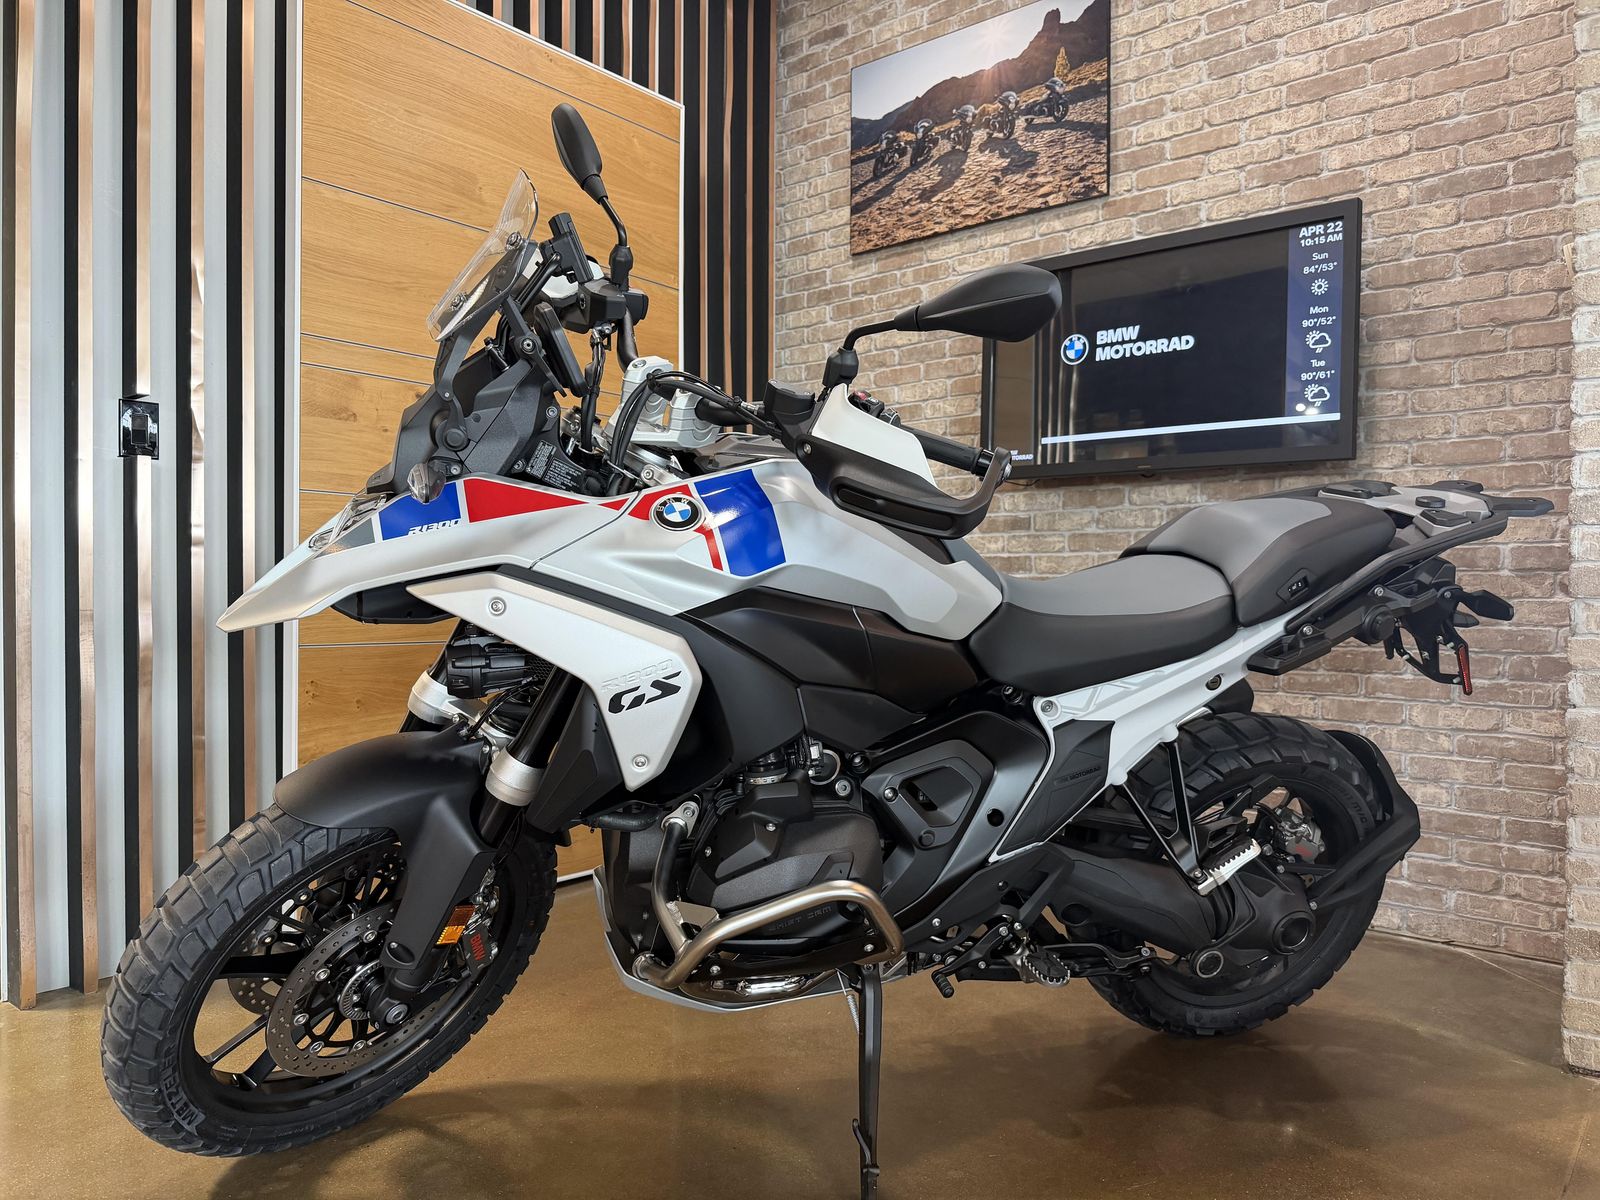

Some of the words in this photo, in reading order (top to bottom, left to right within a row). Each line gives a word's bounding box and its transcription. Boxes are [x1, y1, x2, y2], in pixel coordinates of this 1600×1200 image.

[1299, 224, 1324, 238] APR
[1326, 221, 1343, 233] 22
[1300, 236, 1326, 247] 10:15
[1326, 233, 1343, 242] AM
[1312, 252, 1328, 260] Sun
[1310, 306, 1329, 314] Mon
[1096, 325, 1140, 344] BMW
[1096, 335, 1195, 362] MOTORRAD
[657, 498, 689, 512] BMW
[608, 670, 682, 714] GS
[470, 934, 486, 960] BMW
